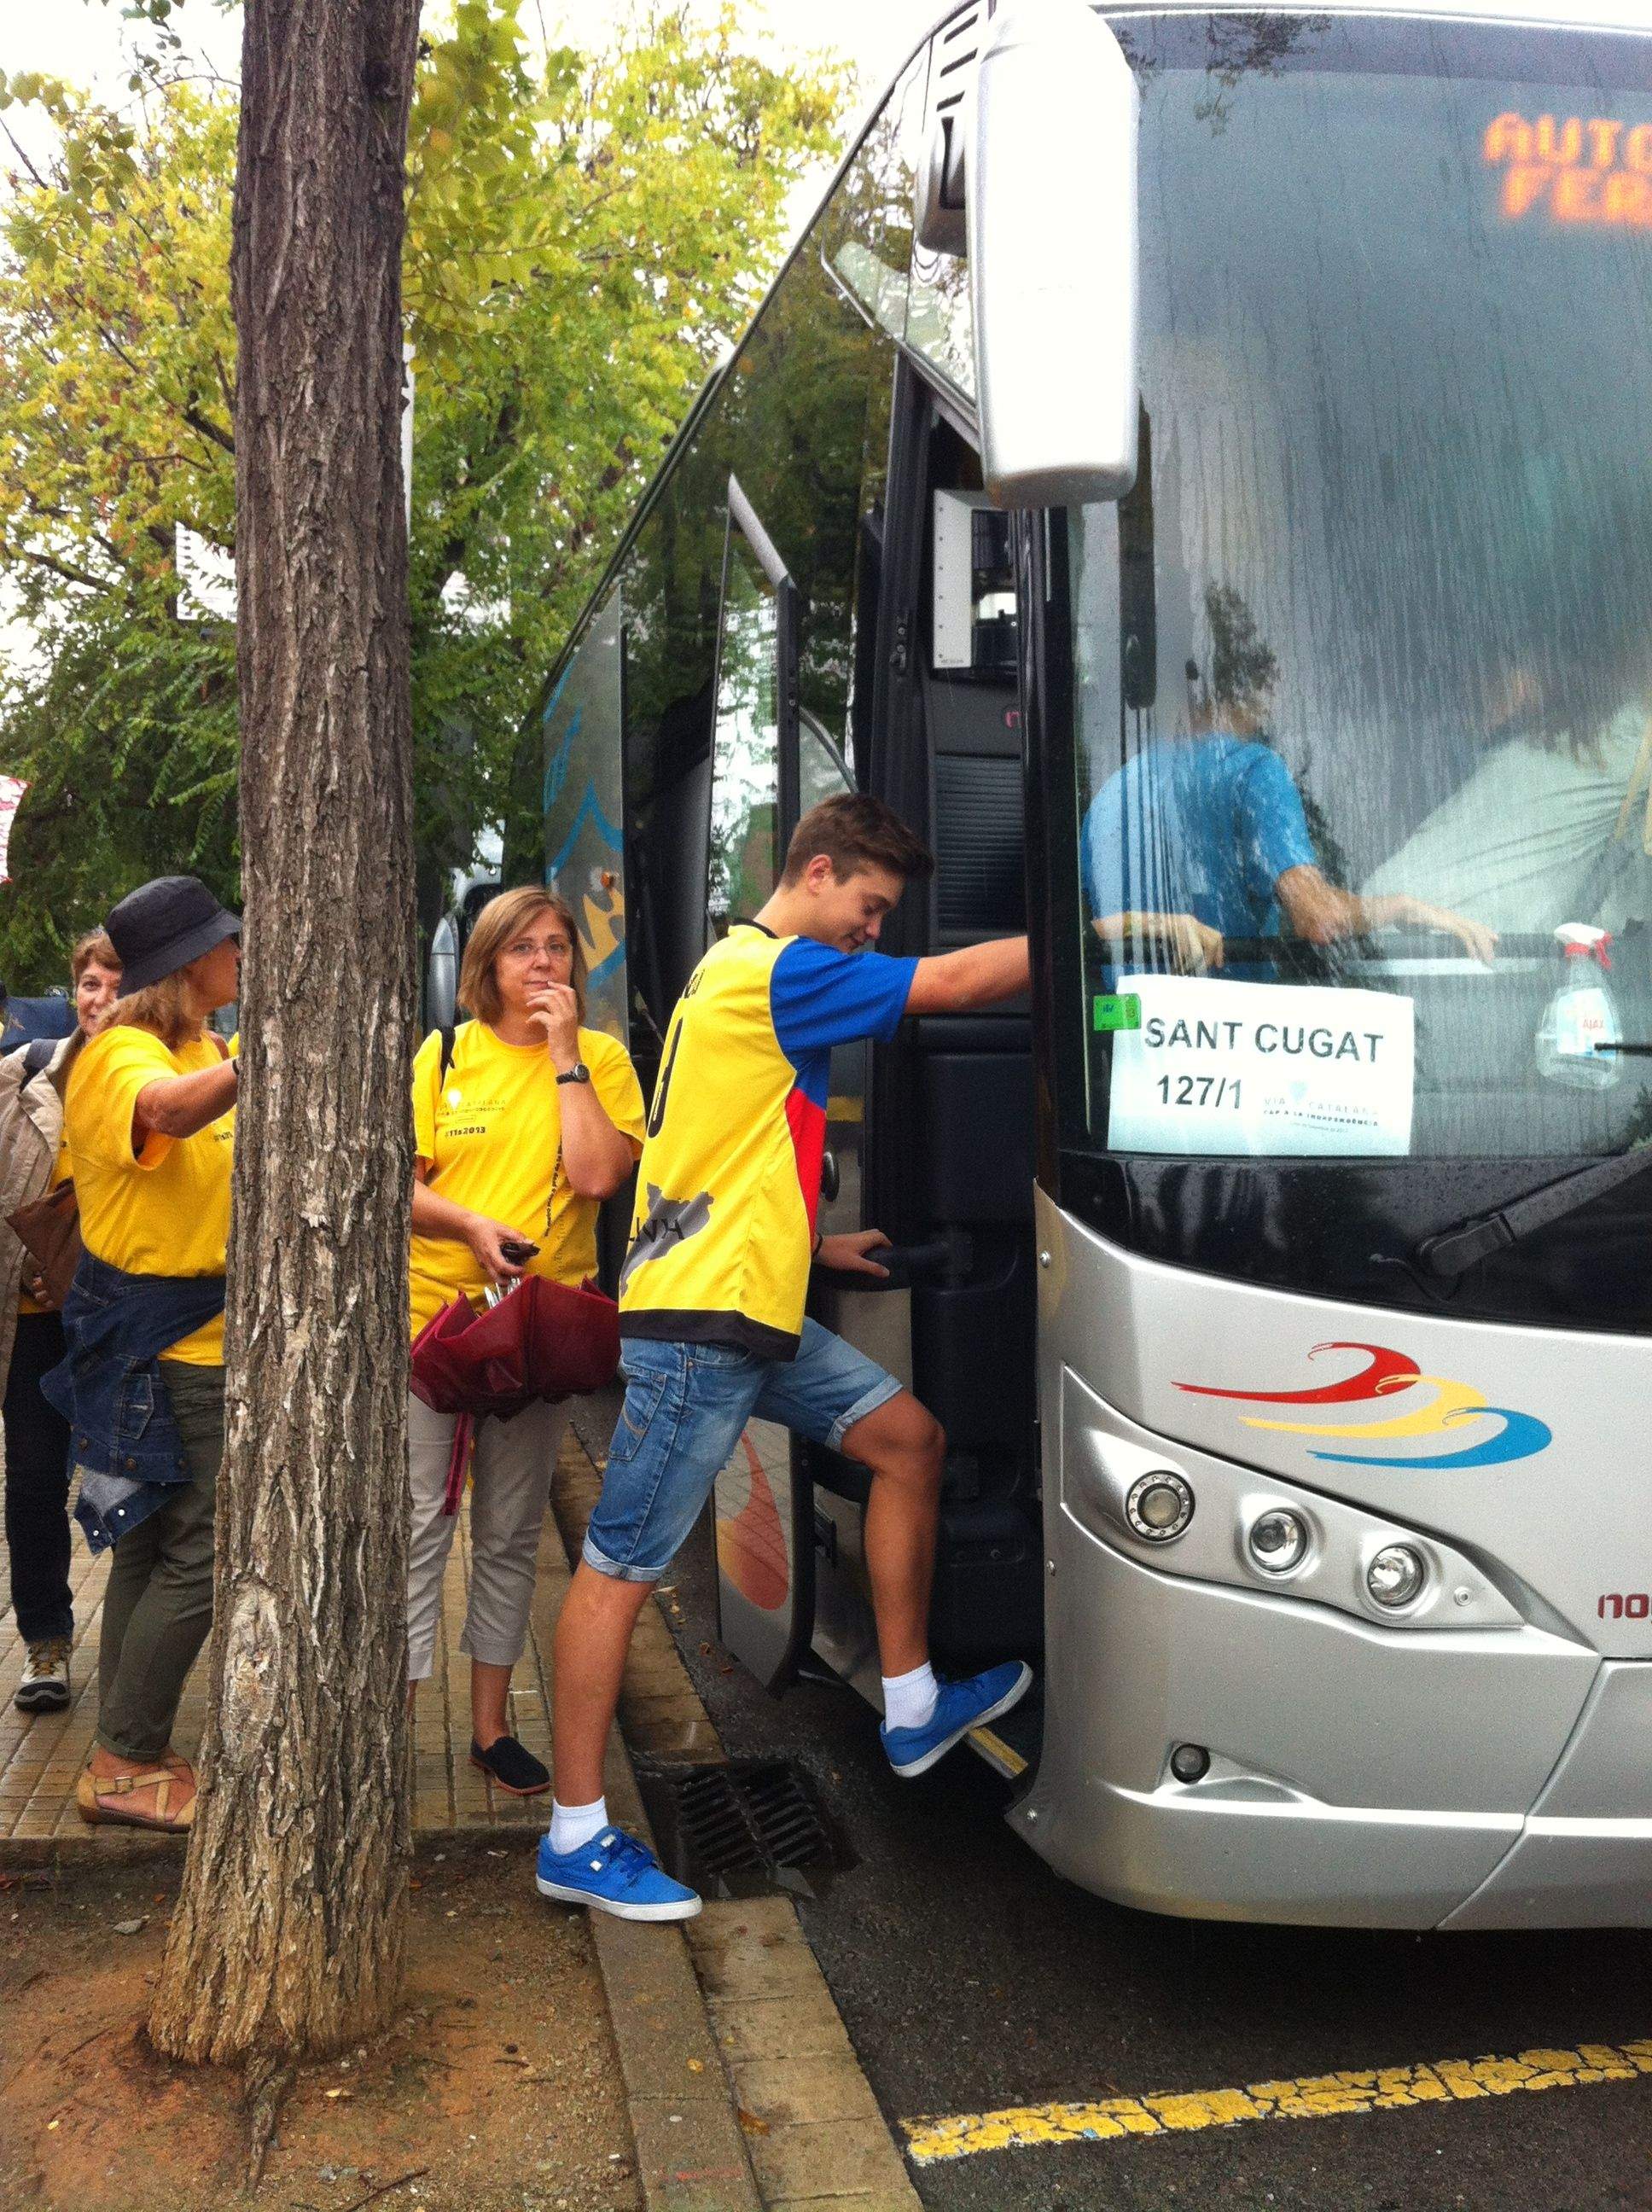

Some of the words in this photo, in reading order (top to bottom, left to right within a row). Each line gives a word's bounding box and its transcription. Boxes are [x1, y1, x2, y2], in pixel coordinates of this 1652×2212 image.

[1144, 1017, 1243, 1050] SANT
[1254, 1023, 1384, 1062] CUGAT
[1157, 1074, 1242, 1109] 127/1
[1597, 1593, 1652, 1619] no
